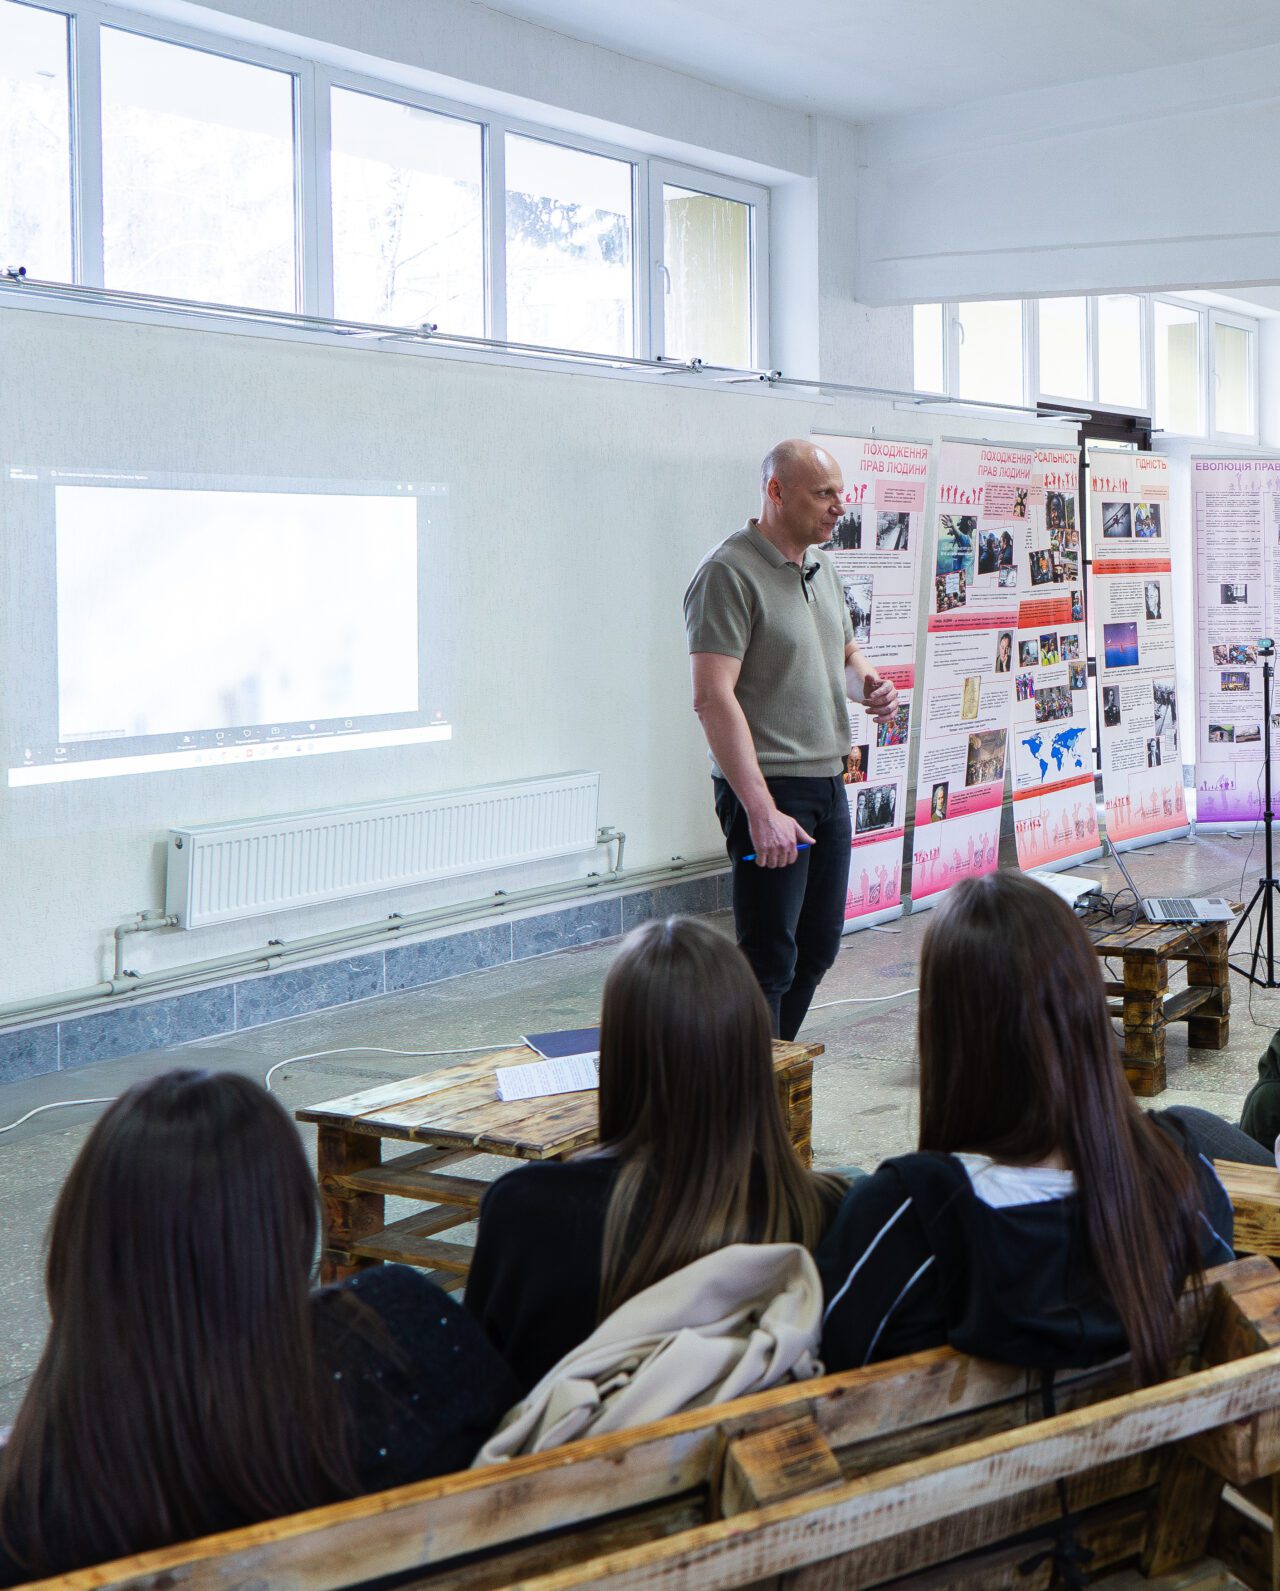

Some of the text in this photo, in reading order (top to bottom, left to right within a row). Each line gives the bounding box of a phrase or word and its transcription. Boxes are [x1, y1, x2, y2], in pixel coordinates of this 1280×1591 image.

[863, 443, 928, 459] ПОХОДЖЕННЯ
[981, 450, 1032, 464] ПОХОДЖЕННЯ
[1034, 451, 1077, 464] РСАЛЬНІСТЬ
[860, 459, 927, 476] ПРАВ ЛЮДИНИ
[1136, 458, 1167, 470] ГІДНІСТЬ
[1195, 462, 1252, 472] ЕВОЛЮЦІЯ
[978, 465, 1031, 480] ПРАВ ЛЮДИНИ
